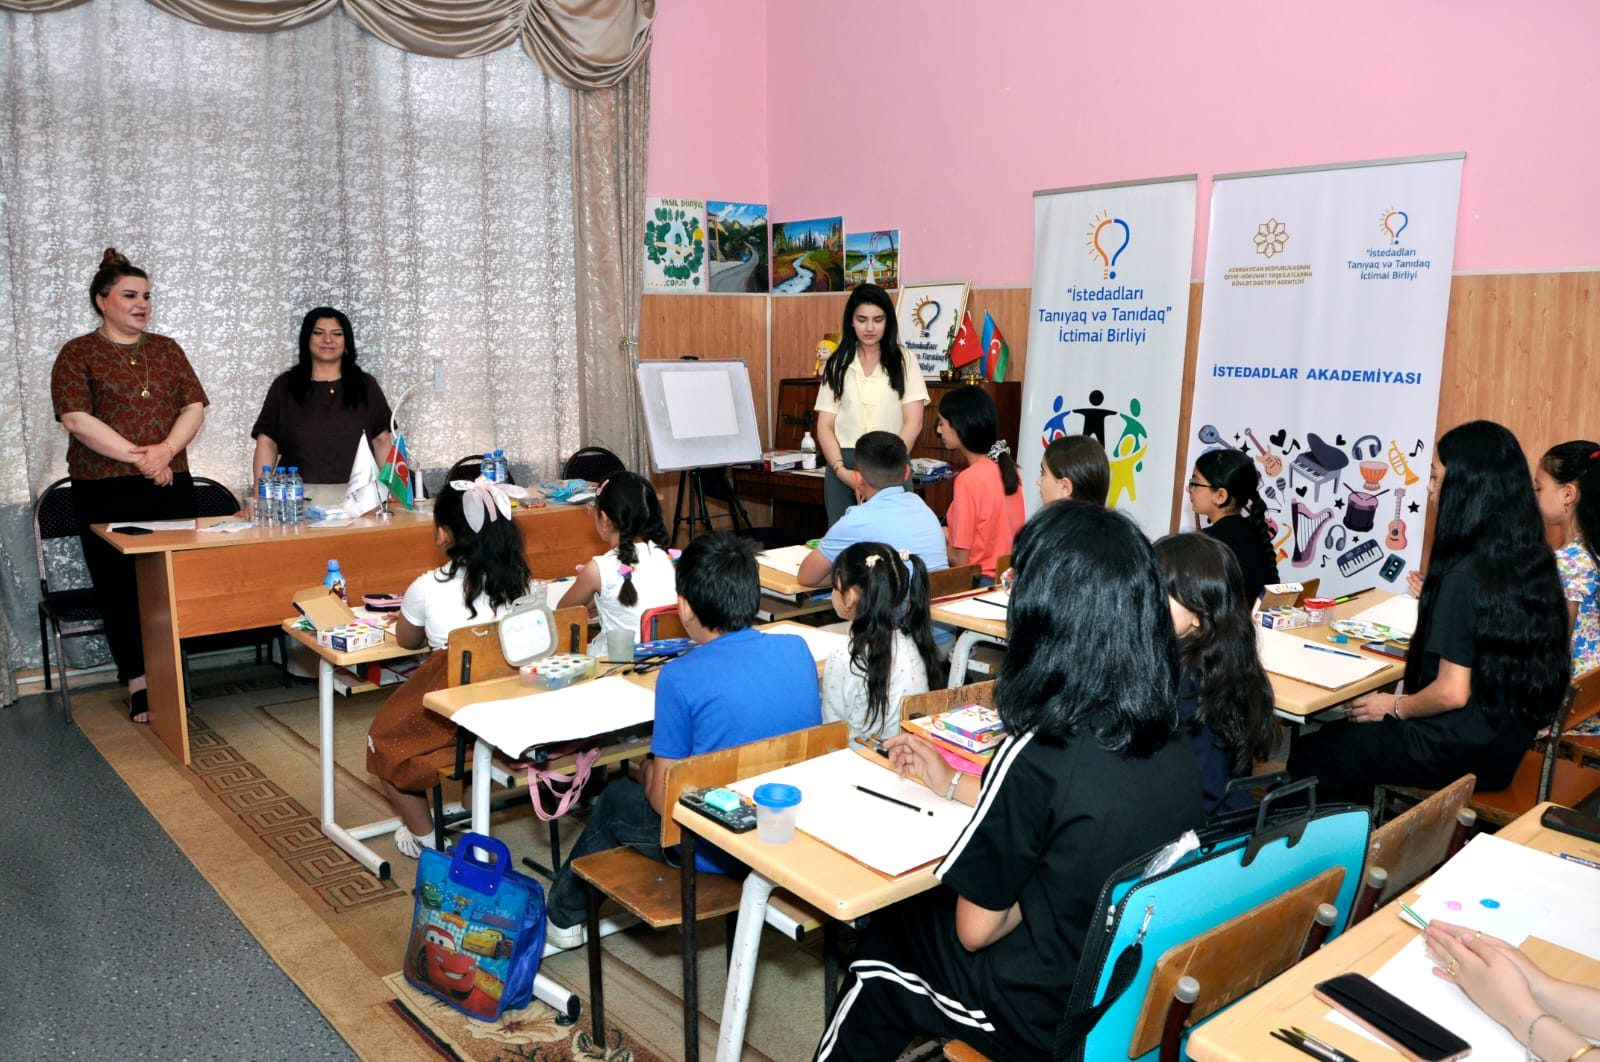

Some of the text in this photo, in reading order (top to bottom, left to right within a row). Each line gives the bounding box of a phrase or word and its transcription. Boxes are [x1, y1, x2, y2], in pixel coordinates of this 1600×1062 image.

[1392, 270, 1418, 280] Birliyi
[1039, 306, 1172, 325] Tanıyaq və Tanıdaq”
[1059, 326, 1146, 345] İctimai Birliyi
[1212, 363, 1422, 385] İSTEDADLAR AKADEMİYASI
